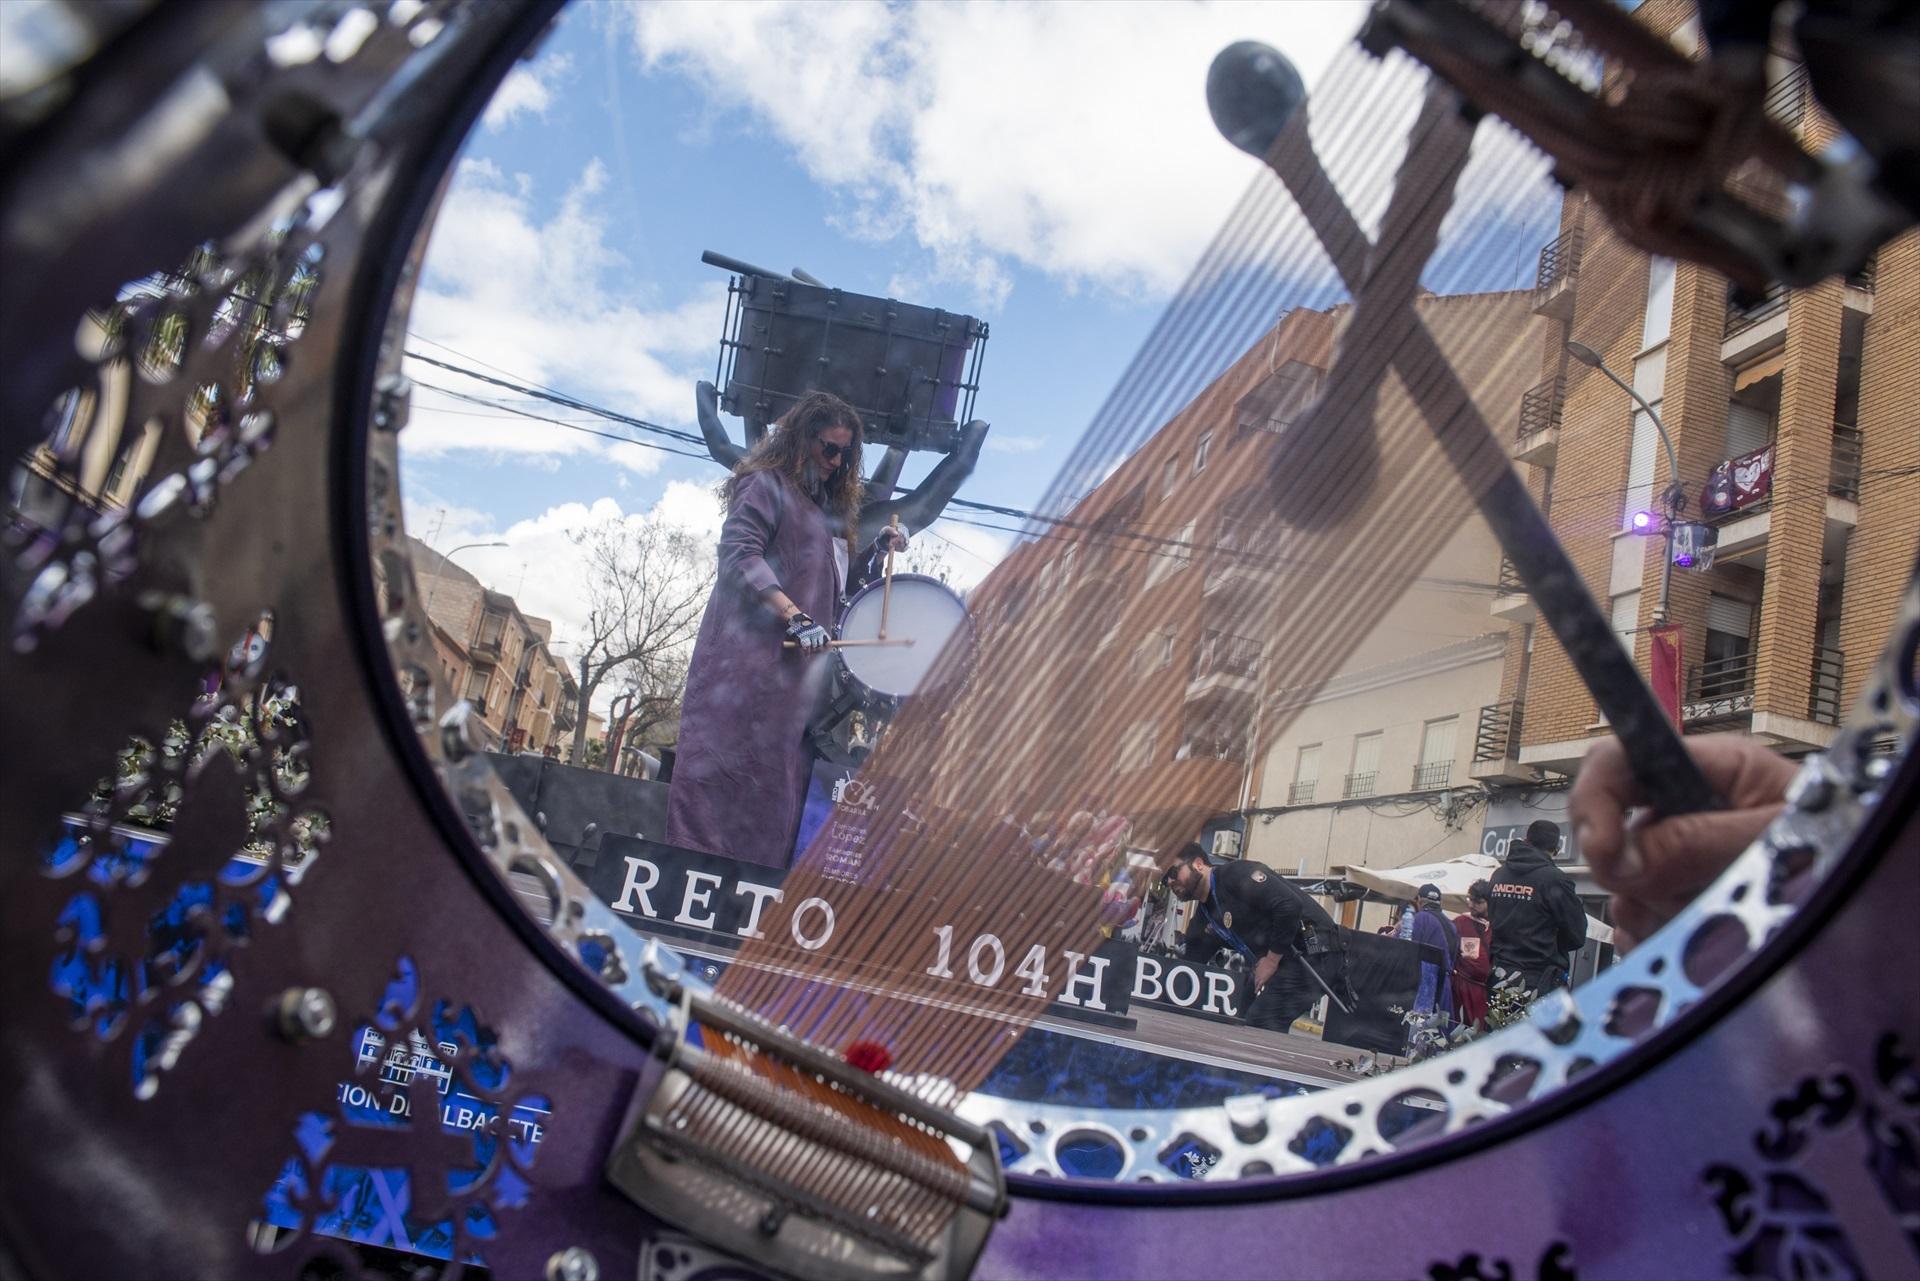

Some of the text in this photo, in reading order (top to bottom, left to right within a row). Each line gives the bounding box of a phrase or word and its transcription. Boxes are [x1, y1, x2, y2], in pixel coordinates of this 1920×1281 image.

[611, 856, 1111, 1010] RETO 104H
[1131, 955, 1238, 1017] BOR
